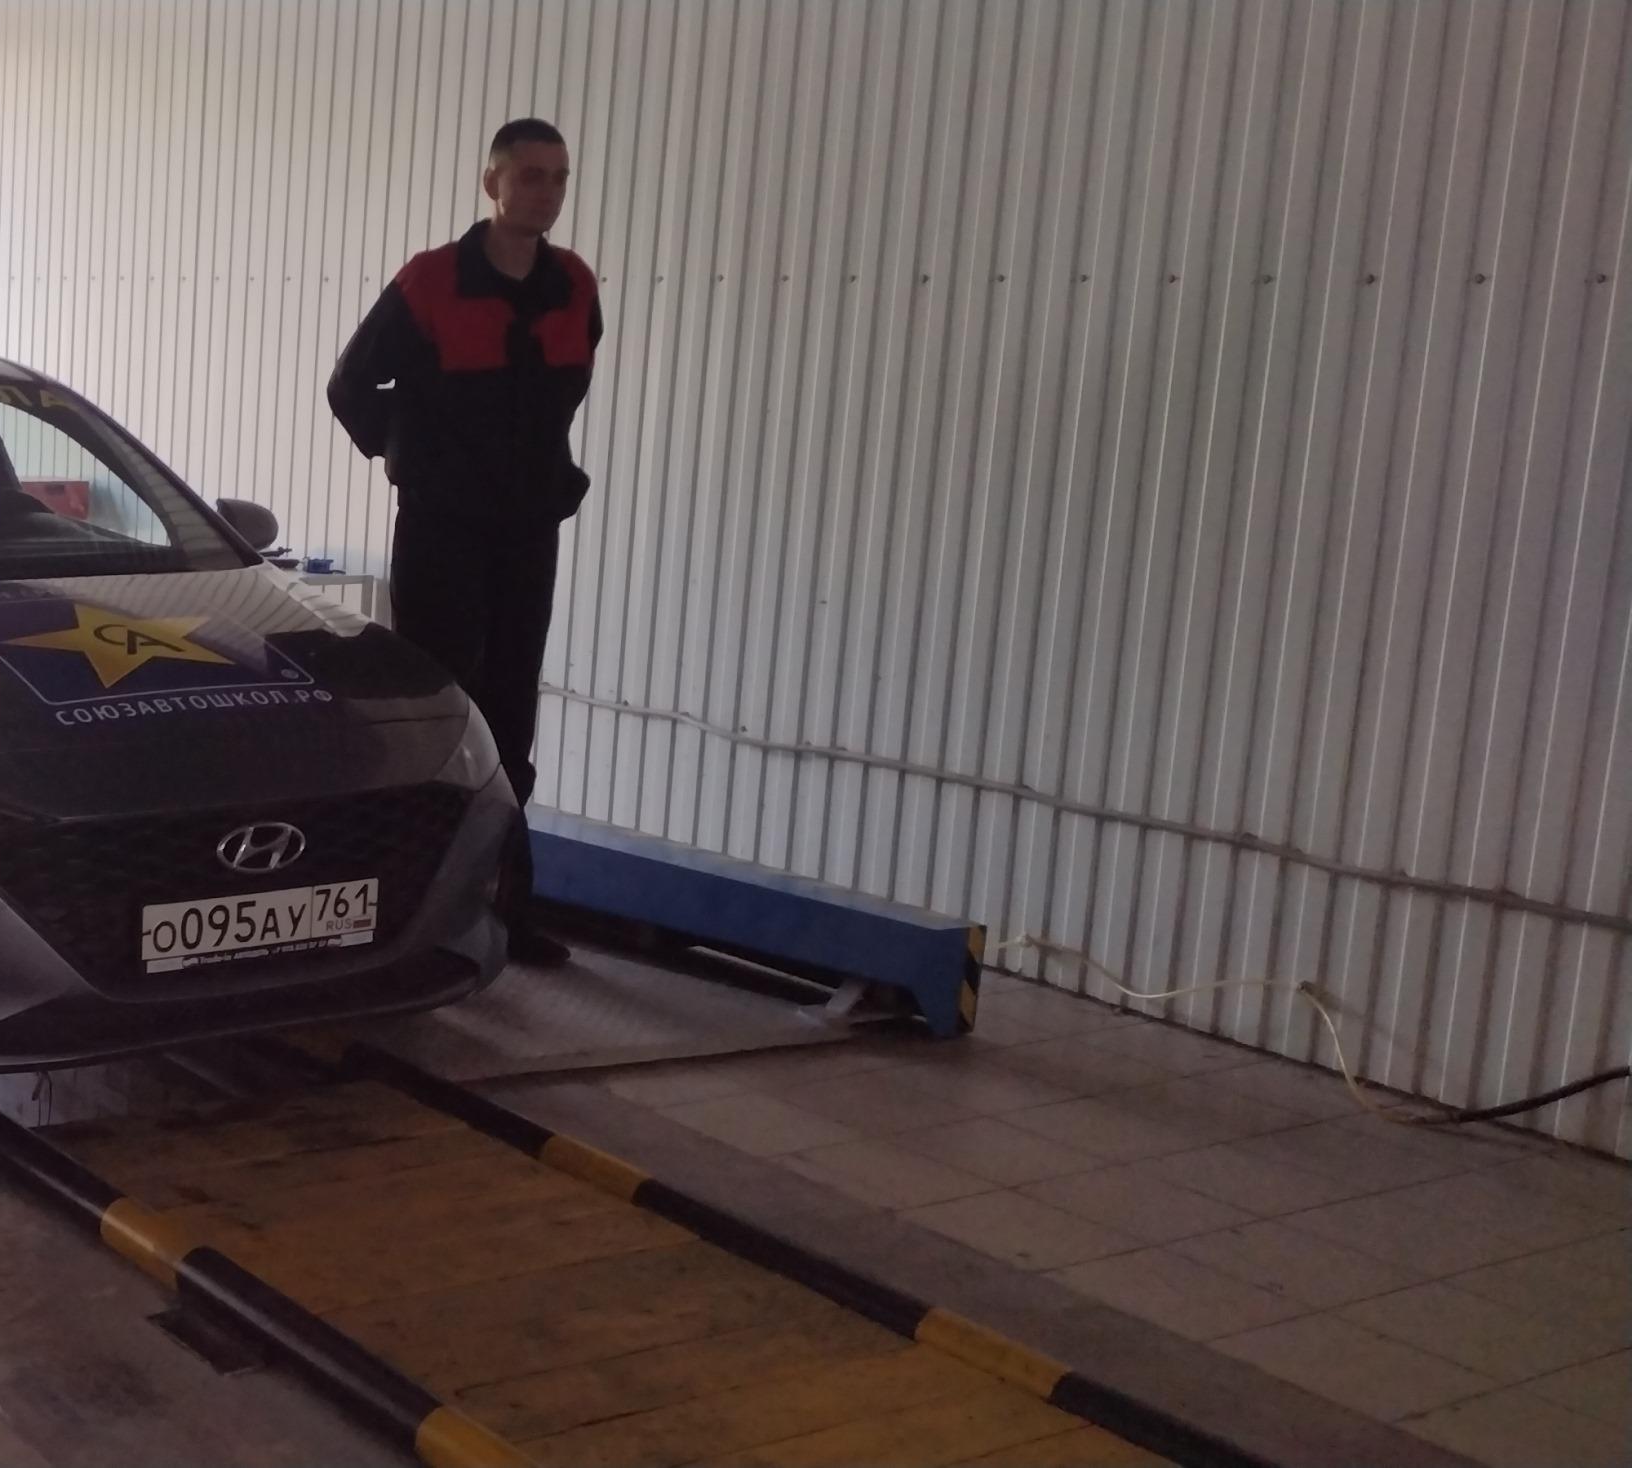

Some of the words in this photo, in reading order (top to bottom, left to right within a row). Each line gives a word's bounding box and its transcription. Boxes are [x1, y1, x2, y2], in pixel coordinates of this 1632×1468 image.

[55, 689, 333, 726] СОЮЗАВТОШКОЛ.РФ
[152, 901, 307, 953] О095АУ
[315, 883, 369, 921] 761
[325, 918, 352, 931] RUS
